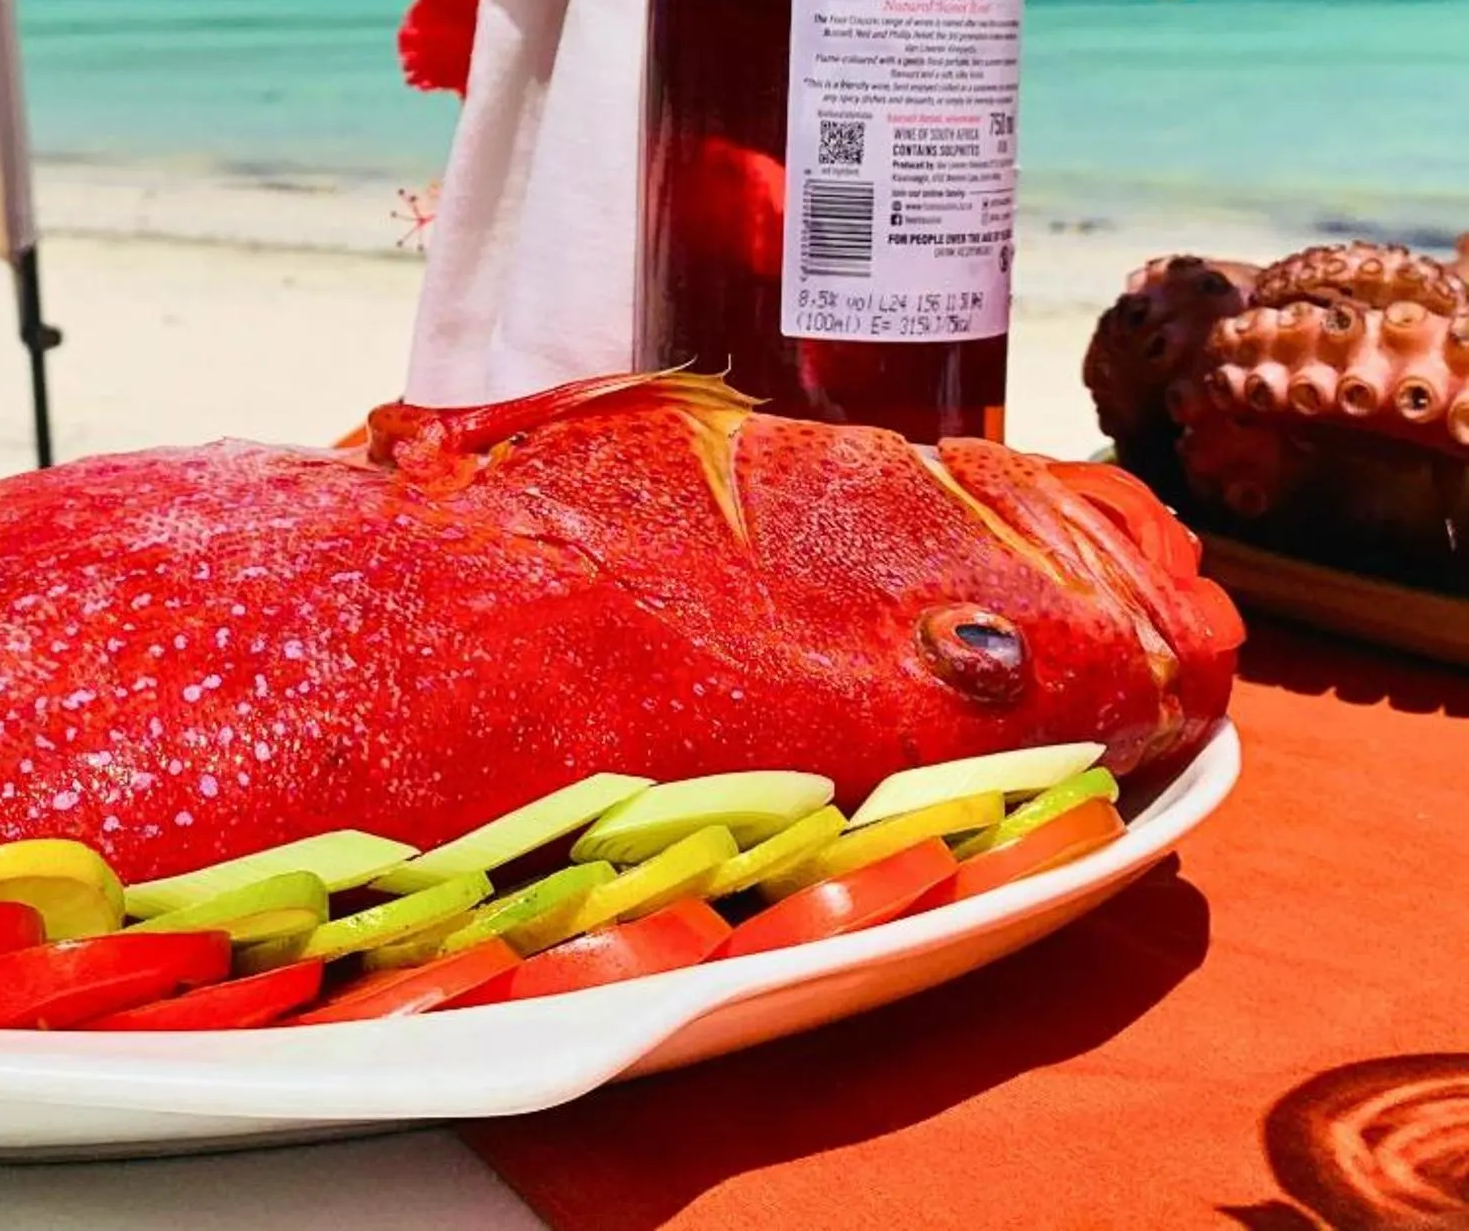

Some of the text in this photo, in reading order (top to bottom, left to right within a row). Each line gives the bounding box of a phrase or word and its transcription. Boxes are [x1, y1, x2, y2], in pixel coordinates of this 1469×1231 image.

[814, 13, 827, 24] The
[893, 128, 980, 141] WINE OF SOUTH AFRICA
[892, 144, 937, 157] CONTAINS
[892, 159, 924, 170] Produced
[888, 233, 908, 245] FOR
[910, 233, 944, 245] PEOPLE
[945, 233, 966, 245] OVER
[798, 289, 839, 309] 8.5%
[846, 294, 873, 312] vol
[796, 311, 861, 334] (100ml)
[871, 316, 892, 335] E=
